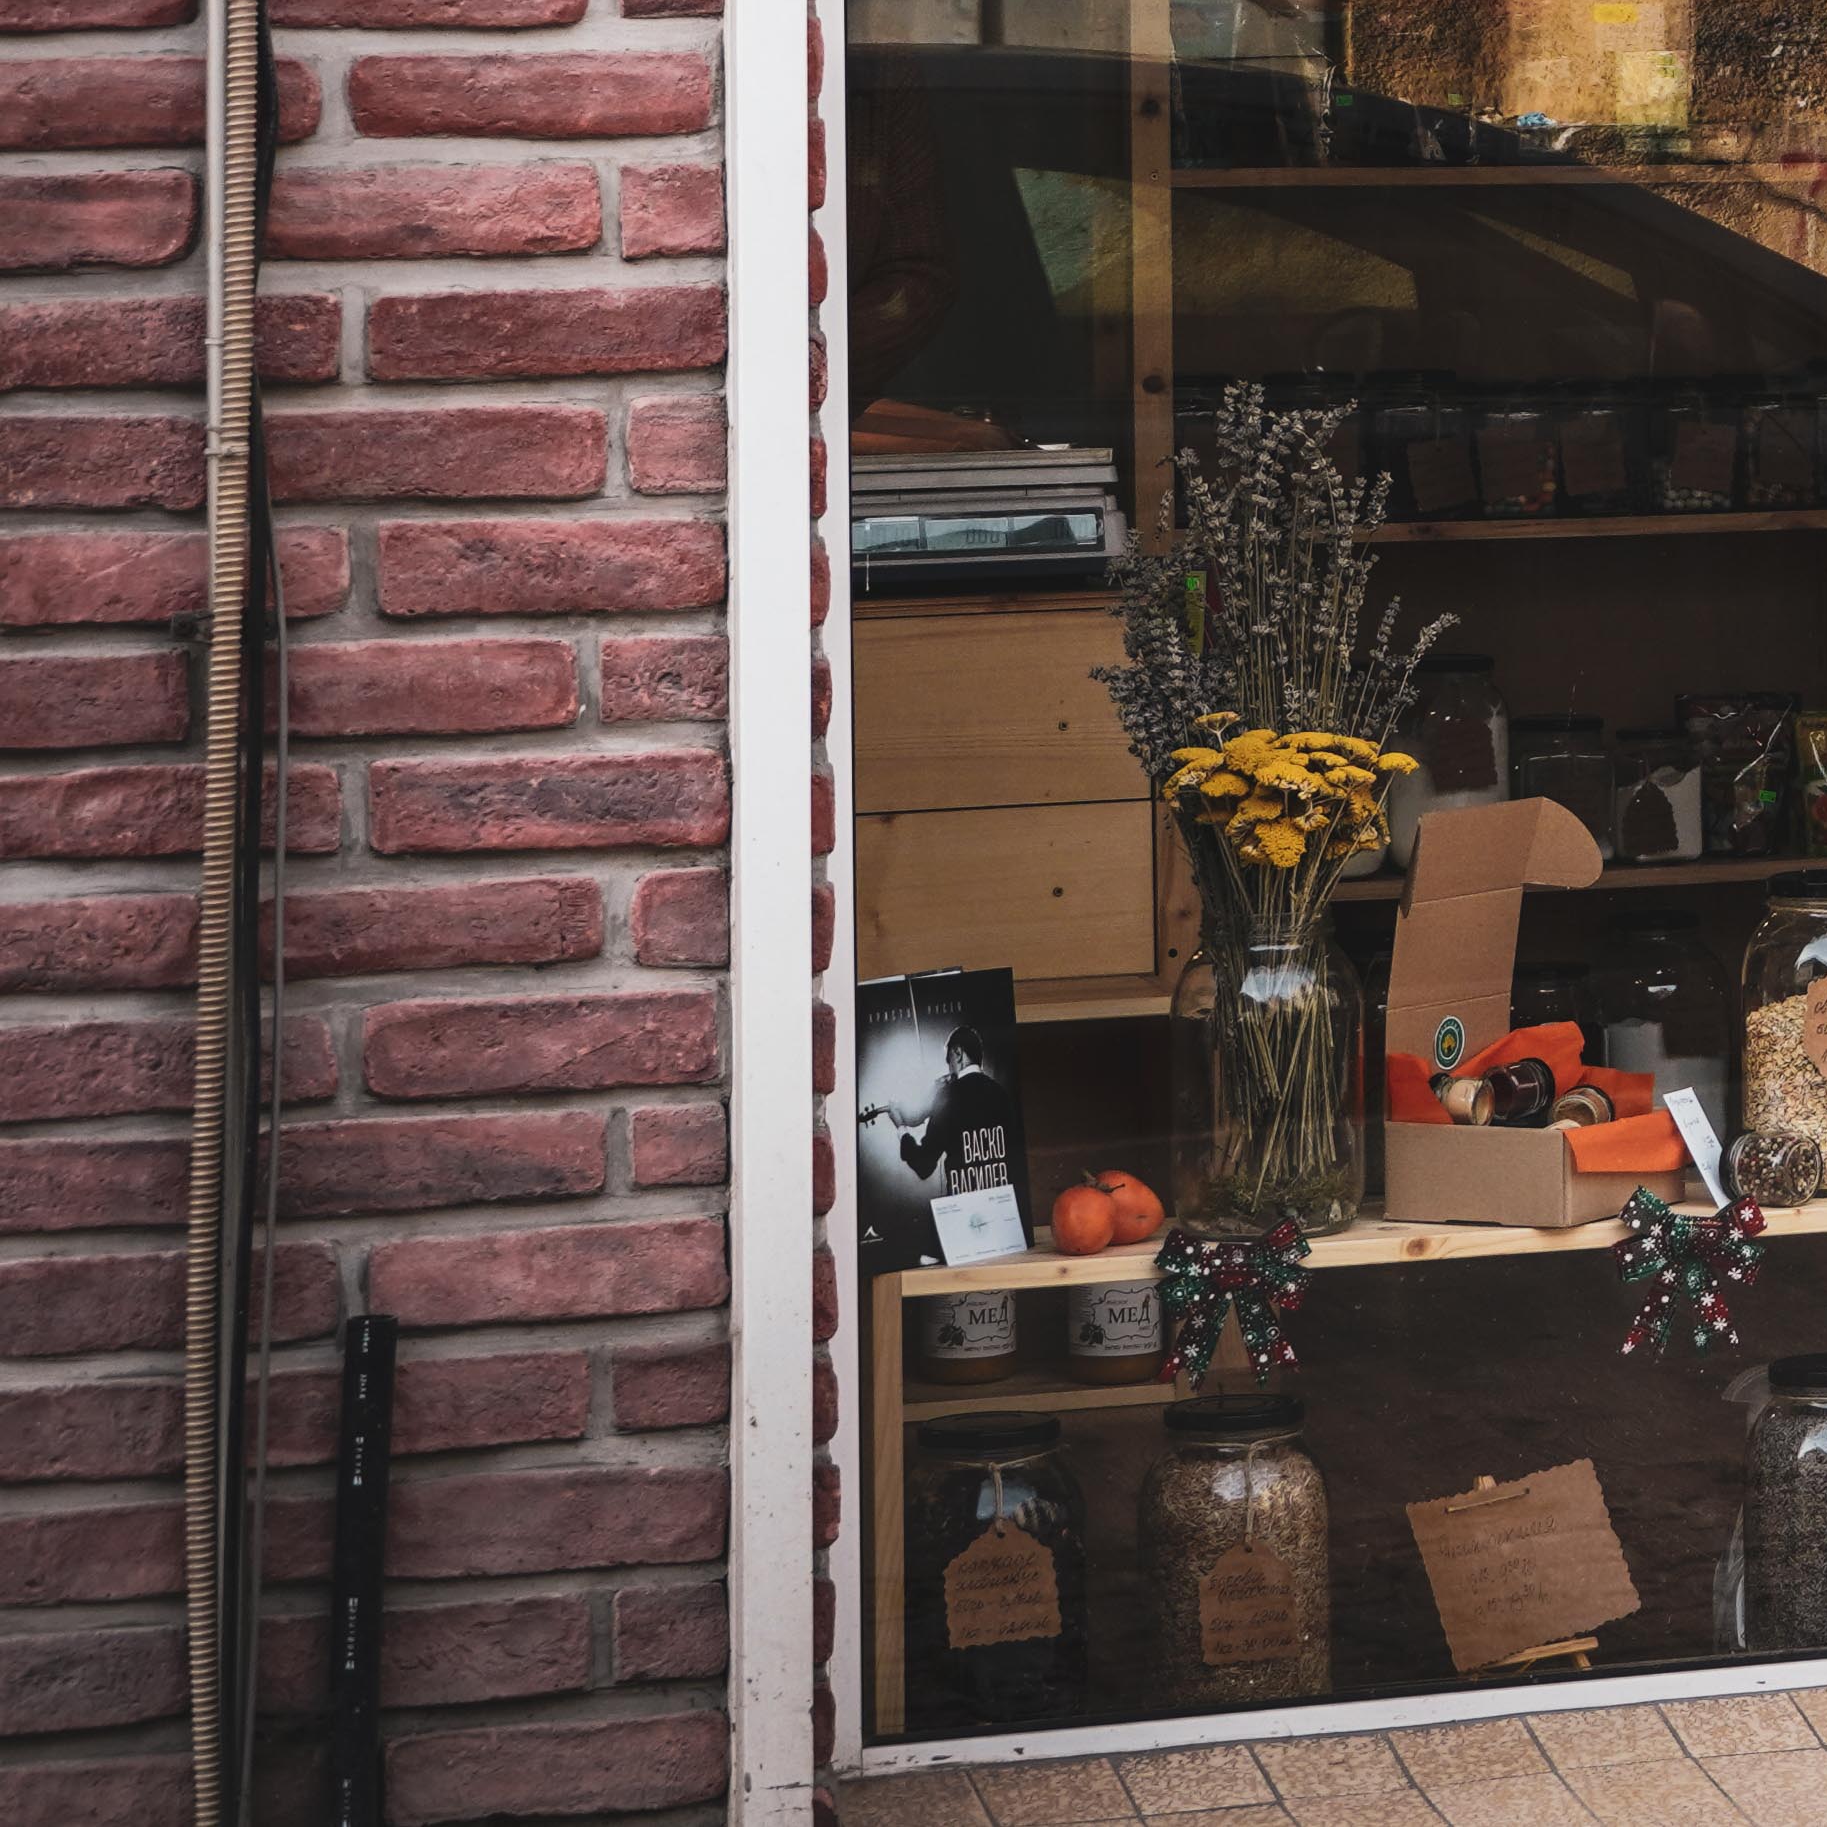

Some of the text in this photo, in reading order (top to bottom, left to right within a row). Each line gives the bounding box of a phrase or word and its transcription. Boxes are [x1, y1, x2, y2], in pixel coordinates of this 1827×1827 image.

[962, 1125, 1007, 1164] ВАСКО
[968, 1300, 1009, 1326] МЕД
[1108, 1300, 1151, 1326] МЕД
